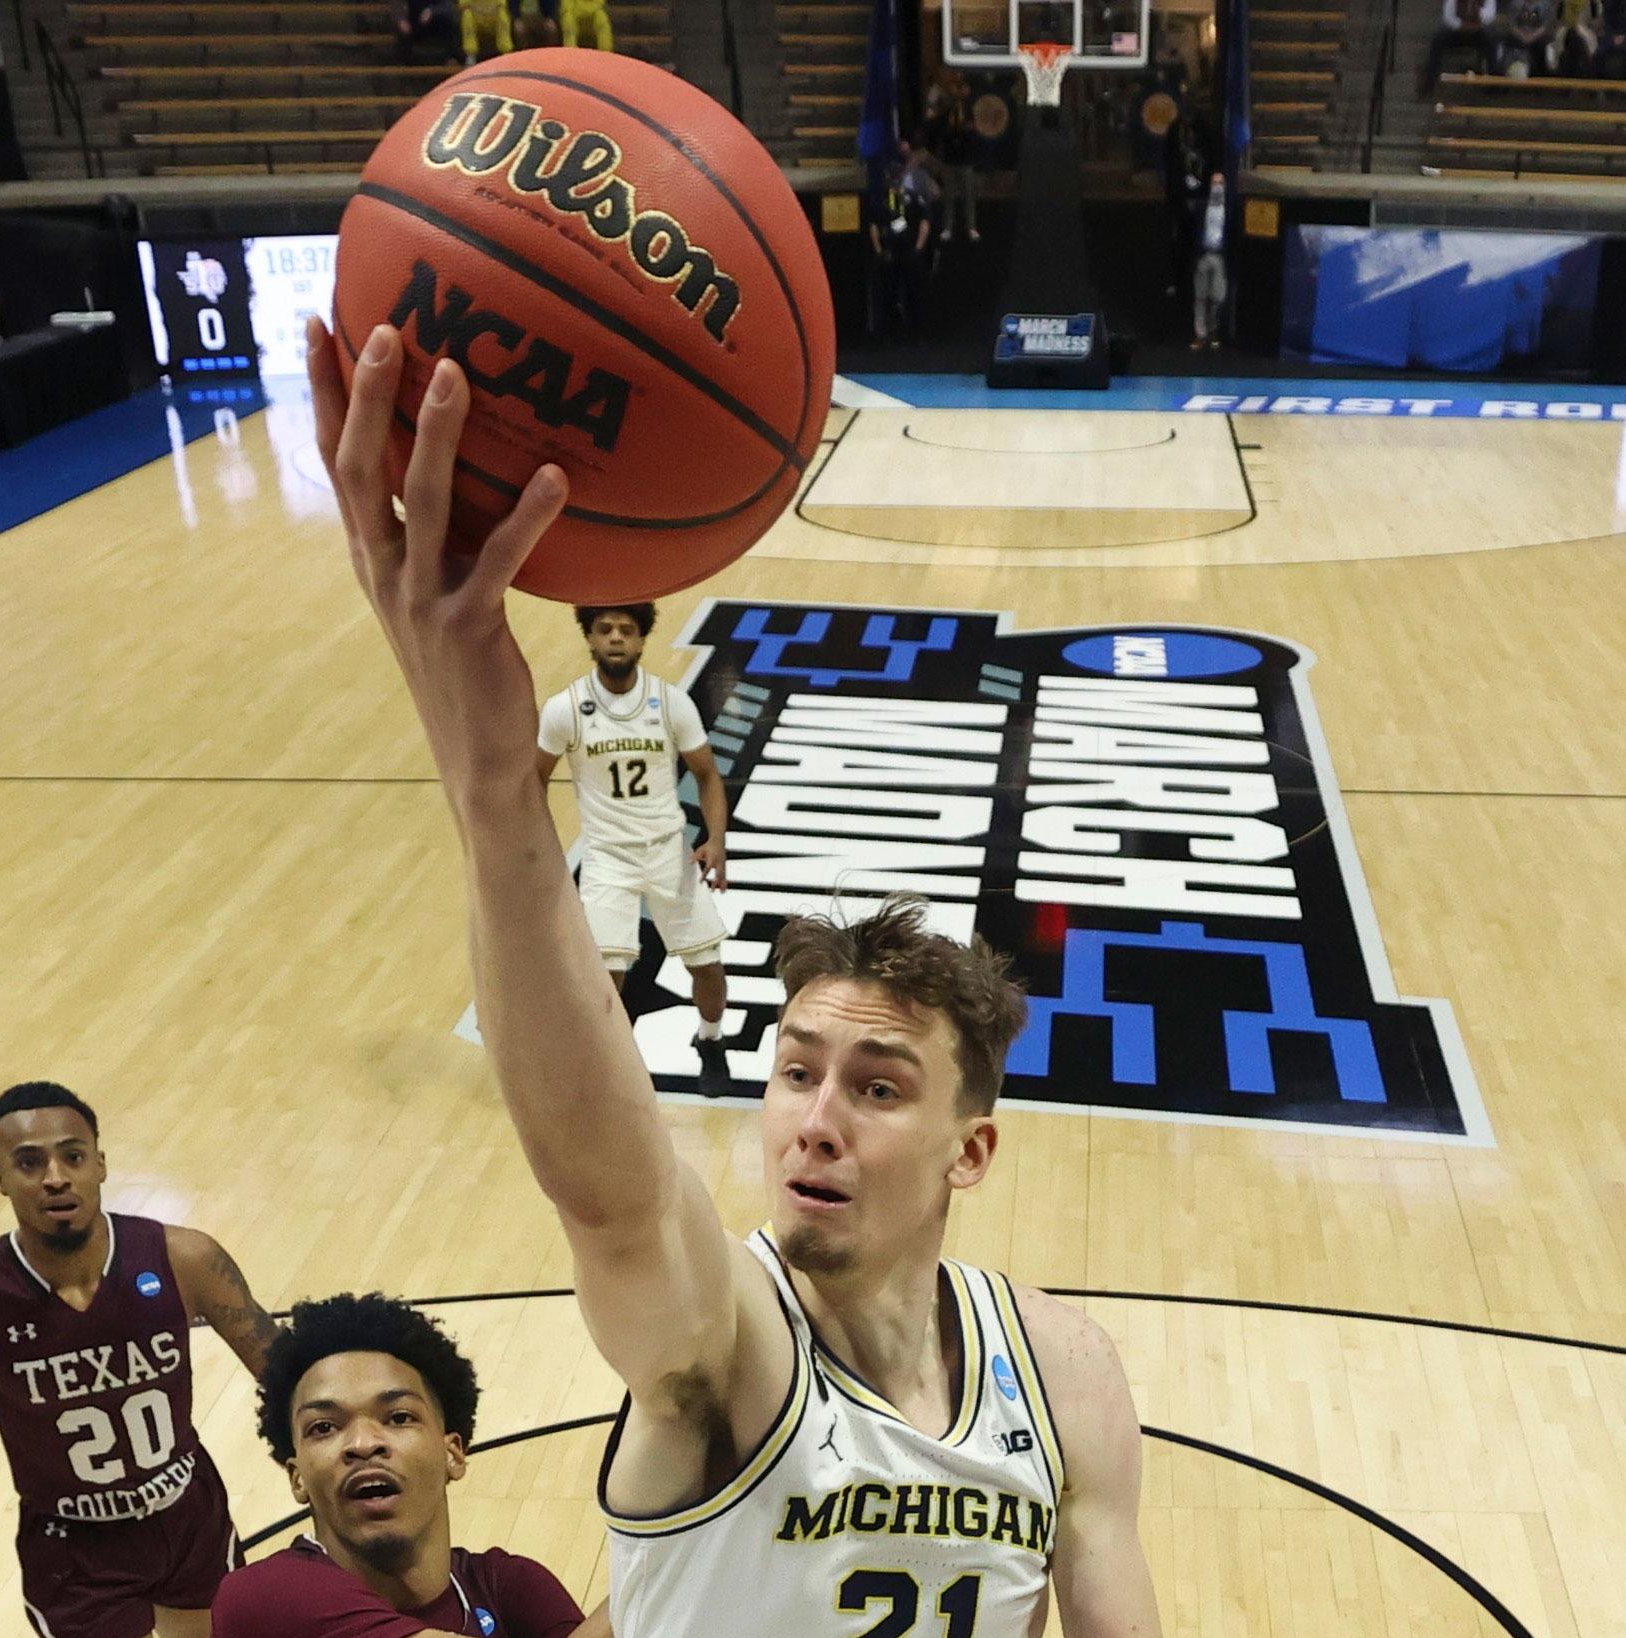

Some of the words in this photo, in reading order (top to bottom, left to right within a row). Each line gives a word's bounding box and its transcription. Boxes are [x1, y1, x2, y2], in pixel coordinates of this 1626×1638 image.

[421, 92, 742, 348] Wilson
[264, 247, 331, 275] 18:37
[198, 308, 227, 351] 0
[1017, 318, 1068, 336] MARCH
[1023, 335, 1091, 354] MADNESS
[388, 259, 632, 454] NCAA
[1181, 393, 1454, 416] FIRST
[586, 737, 664, 758] MICHIGAN
[608, 759, 649, 798] 12
[1015, 674, 1302, 920] MARCH
[13, 1331, 181, 1404] TEXAS
[56, 1389, 176, 1484] 20
[776, 1482, 1054, 1556] MICHIGAN
